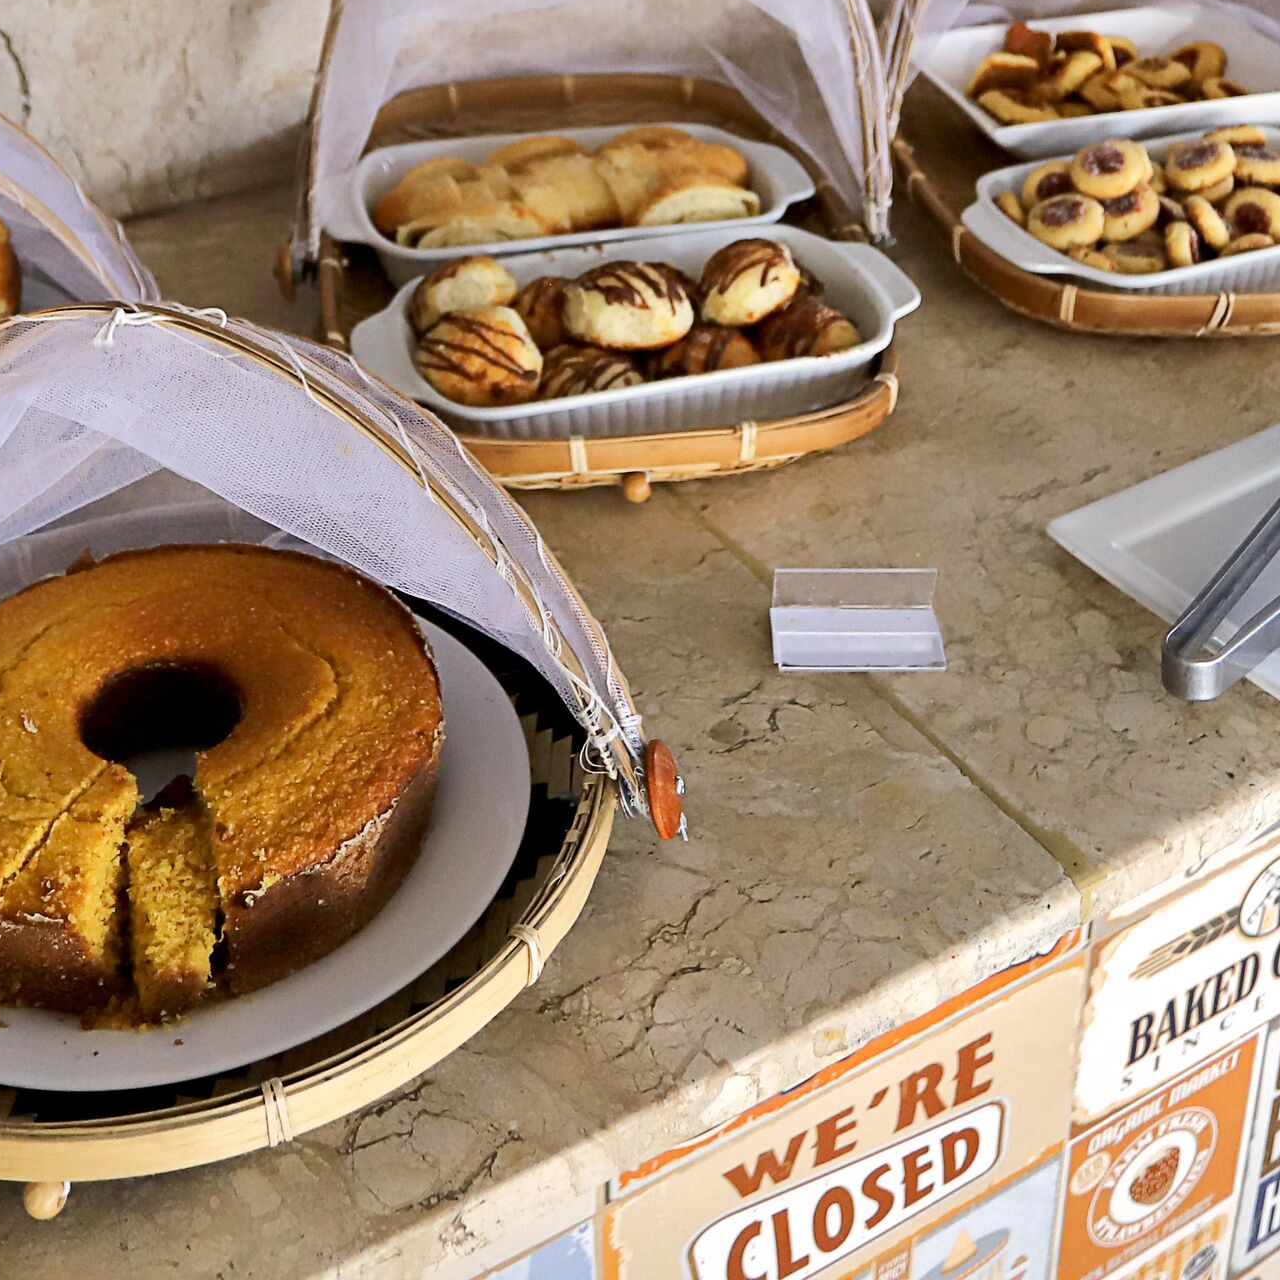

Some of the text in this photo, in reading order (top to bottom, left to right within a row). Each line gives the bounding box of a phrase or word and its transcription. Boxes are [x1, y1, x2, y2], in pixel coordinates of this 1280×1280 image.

[1120, 992, 1267, 1092] SINCE
[1124, 951, 1261, 1069] BAKED
[722, 1030, 995, 1198] WE'RE
[1166, 1049, 1243, 1108] MARKET
[726, 1125, 981, 1280] CLOSED
